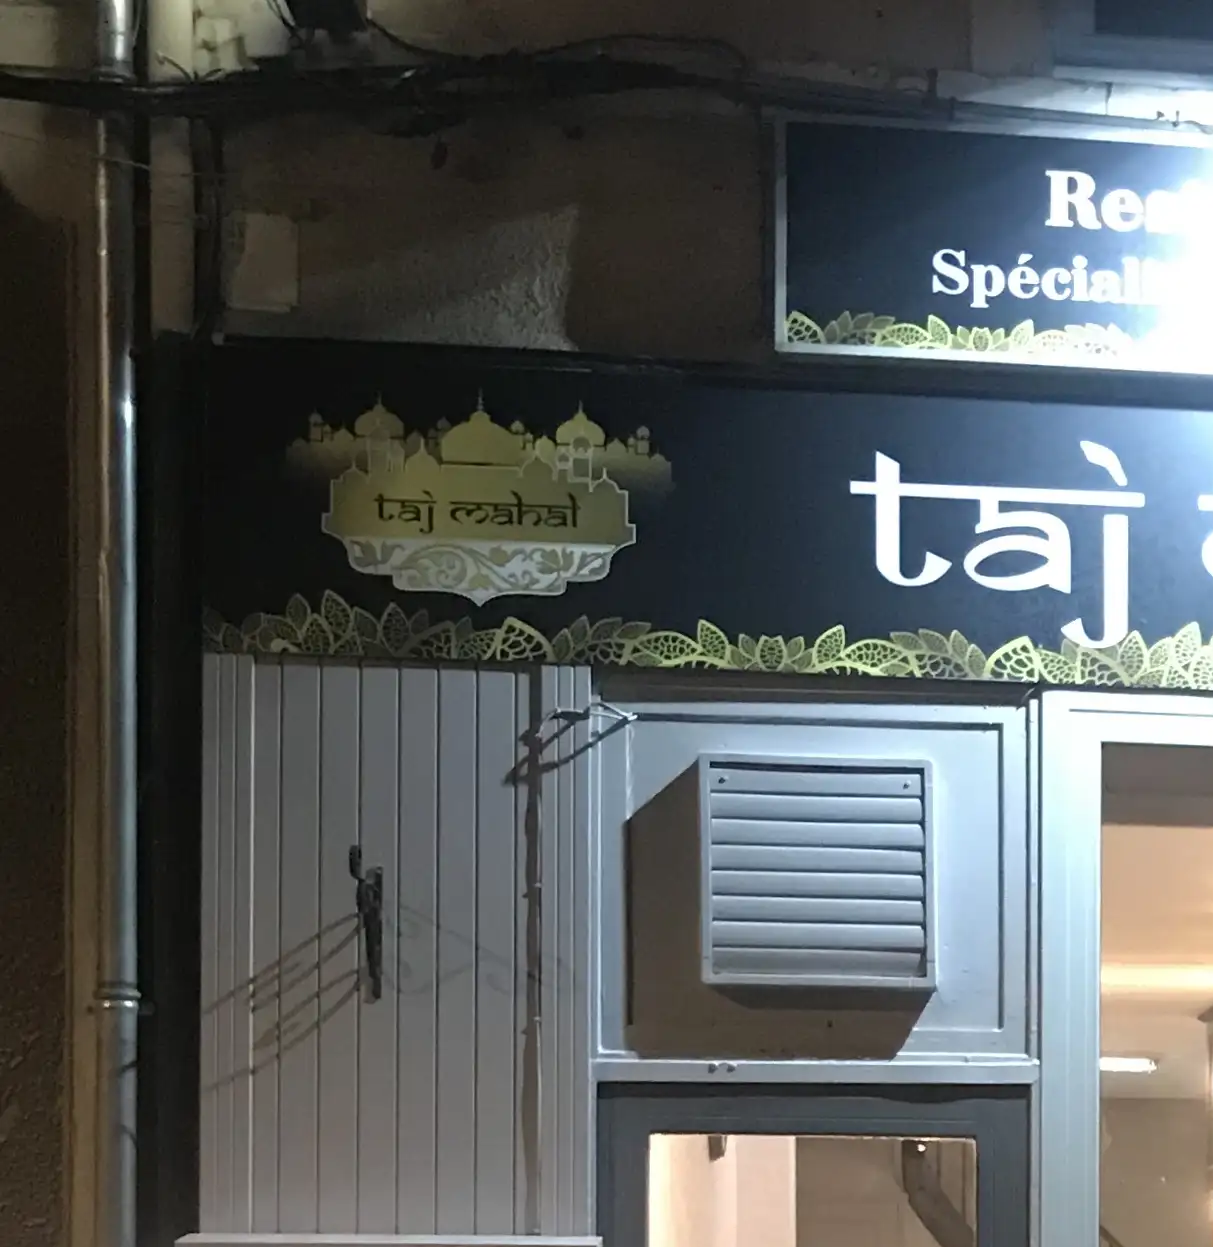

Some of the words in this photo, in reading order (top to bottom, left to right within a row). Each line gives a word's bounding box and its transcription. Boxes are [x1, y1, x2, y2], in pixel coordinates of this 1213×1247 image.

[374, 490, 435, 534] taj
[449, 491, 581, 529] mahal
[850, 440, 1146, 649] taj
